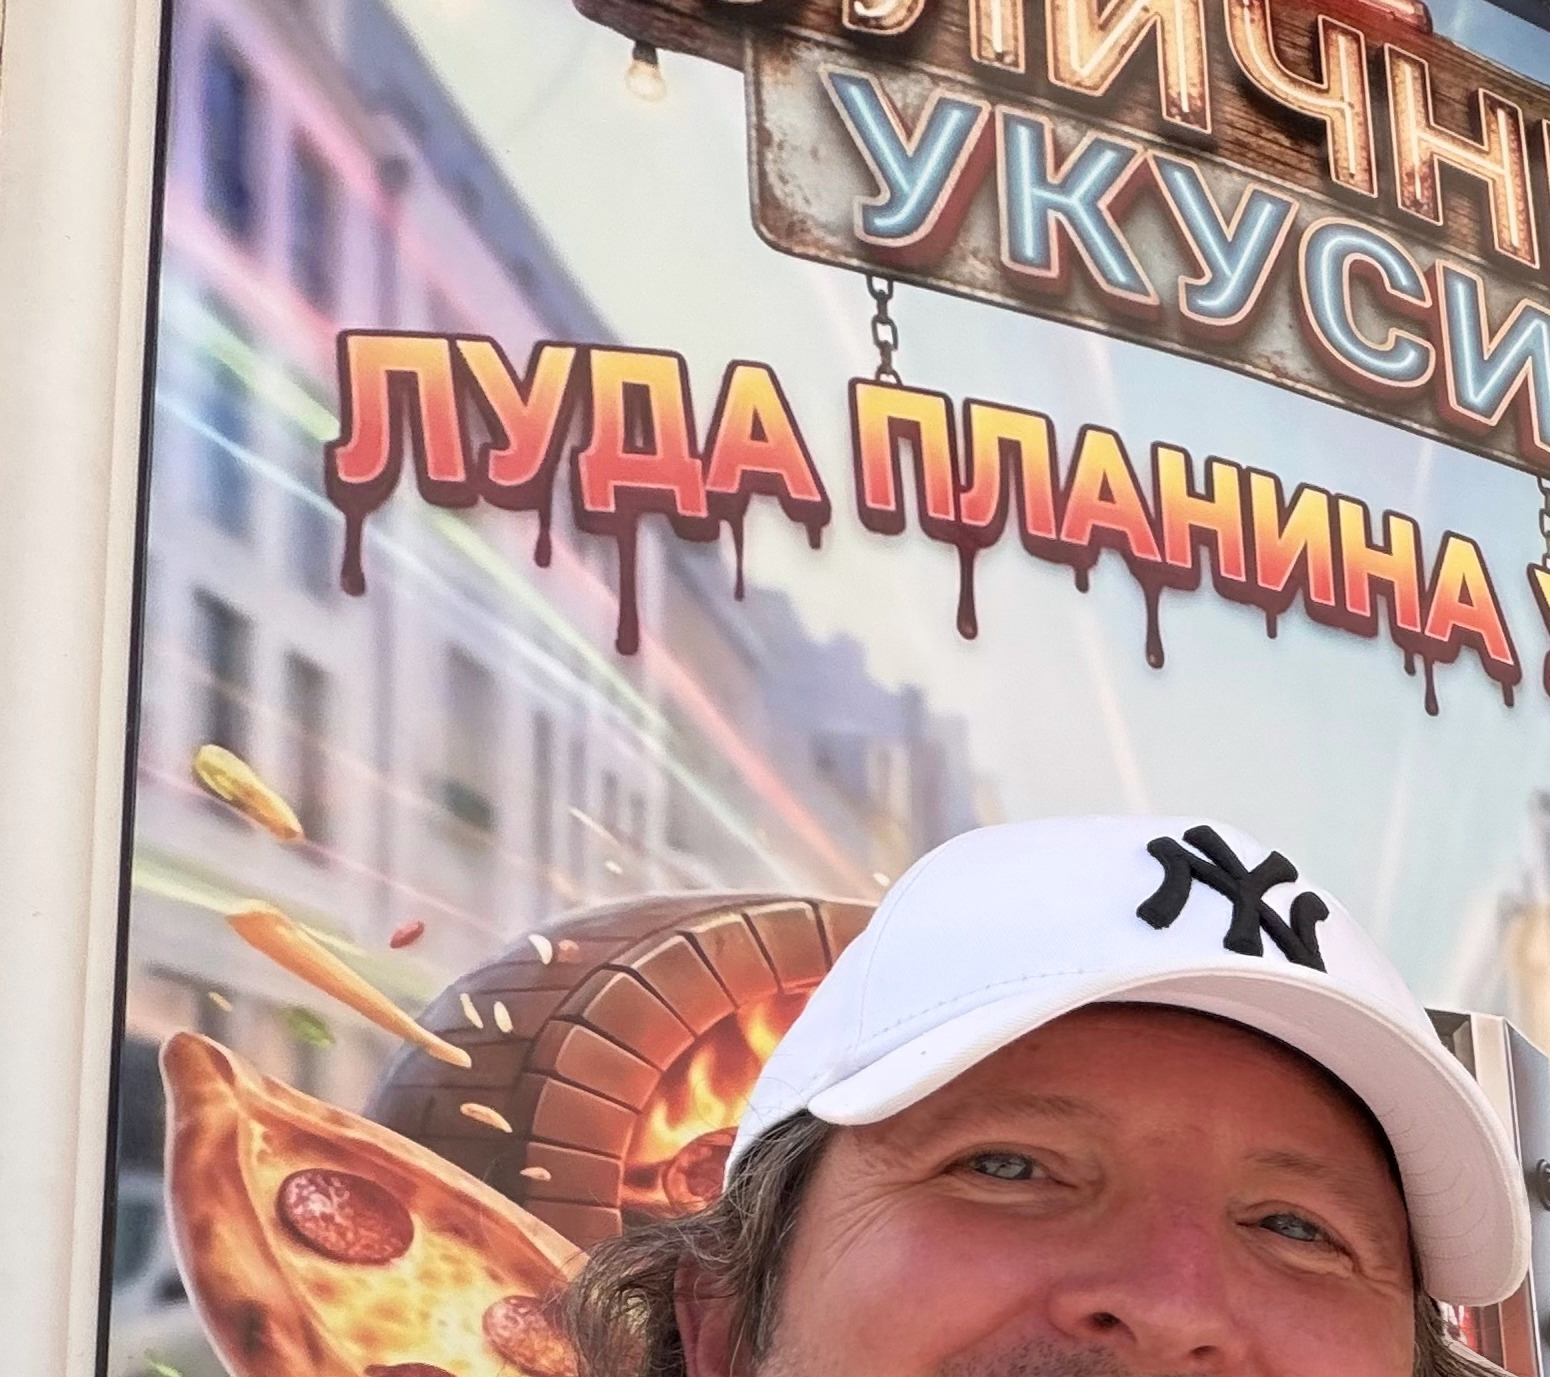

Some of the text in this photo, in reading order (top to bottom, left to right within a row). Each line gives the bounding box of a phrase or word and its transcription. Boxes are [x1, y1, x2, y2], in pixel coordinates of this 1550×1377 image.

[327, 330, 830, 545] ЛУДА
[848, 378, 1521, 686] ПЛАНИНА
[1136, 825, 1329, 973] NY
